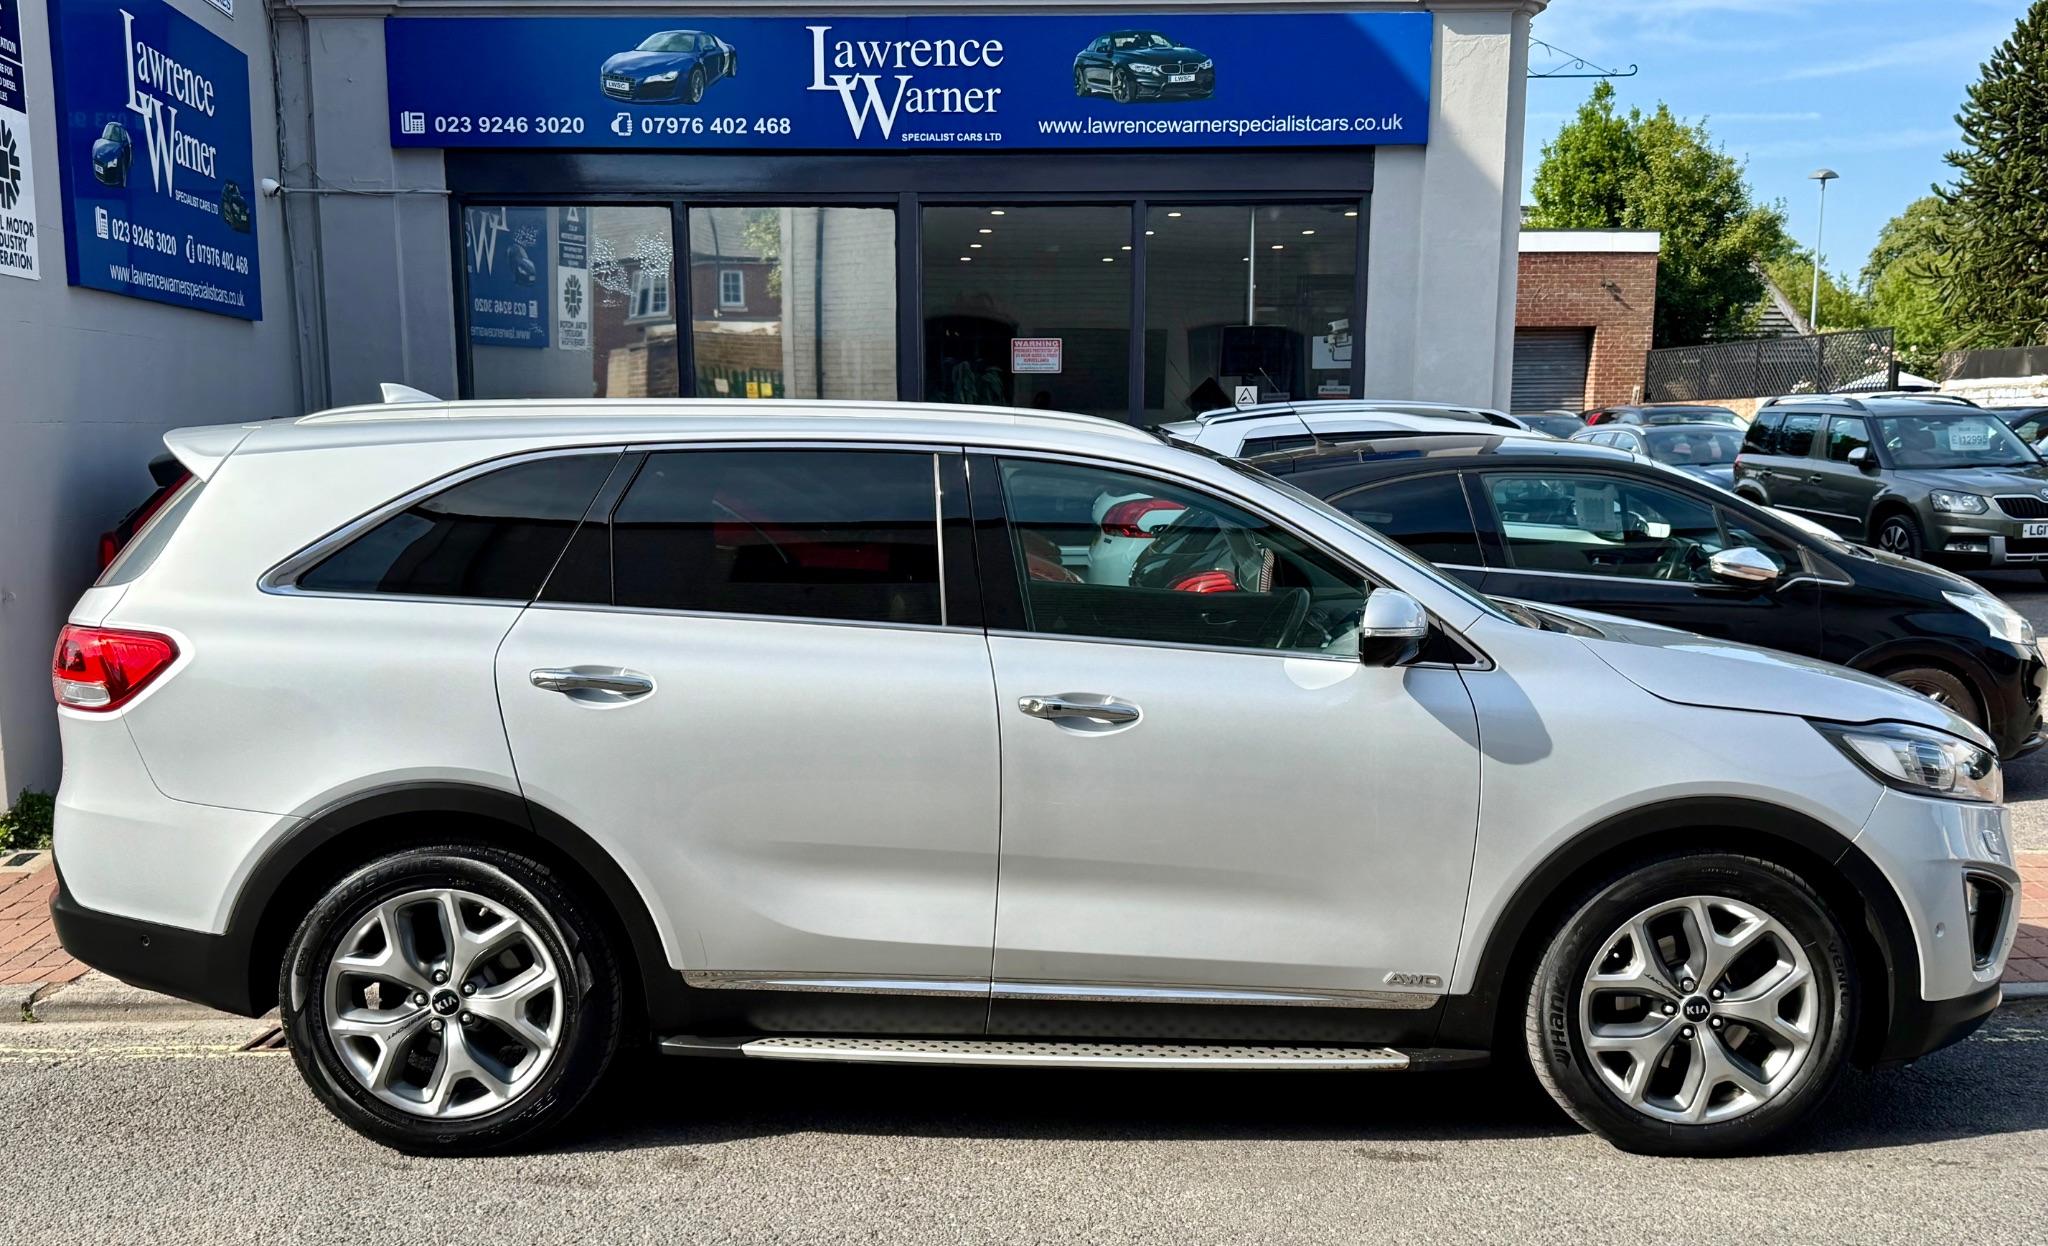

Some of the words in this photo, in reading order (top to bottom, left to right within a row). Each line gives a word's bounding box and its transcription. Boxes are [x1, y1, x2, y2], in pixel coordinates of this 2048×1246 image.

[119, 8, 215, 118] Lawrence
[806, 26, 1004, 91] Lawrence
[829, 74, 1001, 140] Warner
[434, 115, 472, 134] 023
[478, 115, 529, 134] 9246
[535, 115, 585, 134] 3020
[641, 116, 704, 135] 07976
[710, 116, 748, 135] 402
[754, 116, 791, 135] 468
[1038, 113, 1404, 137] www.lawrencewarnerspecialistcars.co.uk
[136, 90, 217, 198] Warner
[901, 133, 955, 142] SPECIALIST
[957, 133, 983, 141] CARS
[984, 133, 1002, 141] LTD
[175, 189, 199, 208] SPECIALIST
[200, 198, 211, 212] CARS
[210, 202, 219, 215] LTD
[6, 216, 35, 238] MOTOR
[112, 218, 131, 243] 023
[132, 226, 155, 250] 9246
[156, 231, 177, 256] 3020
[0, 232, 27, 253] DUSTRY
[197, 243, 221, 268] 07976
[221, 251, 235, 272] 402
[235, 255, 249, 275] 468
[109, 263, 246, 307] www.lawrencewarnerspecialistcars.co.uk
[2029, 525, 2048, 536] LG1
[1383, 971, 1444, 988] AWD
[434, 995, 457, 1012] KIA
[1686, 1005, 1708, 1015] KIA
